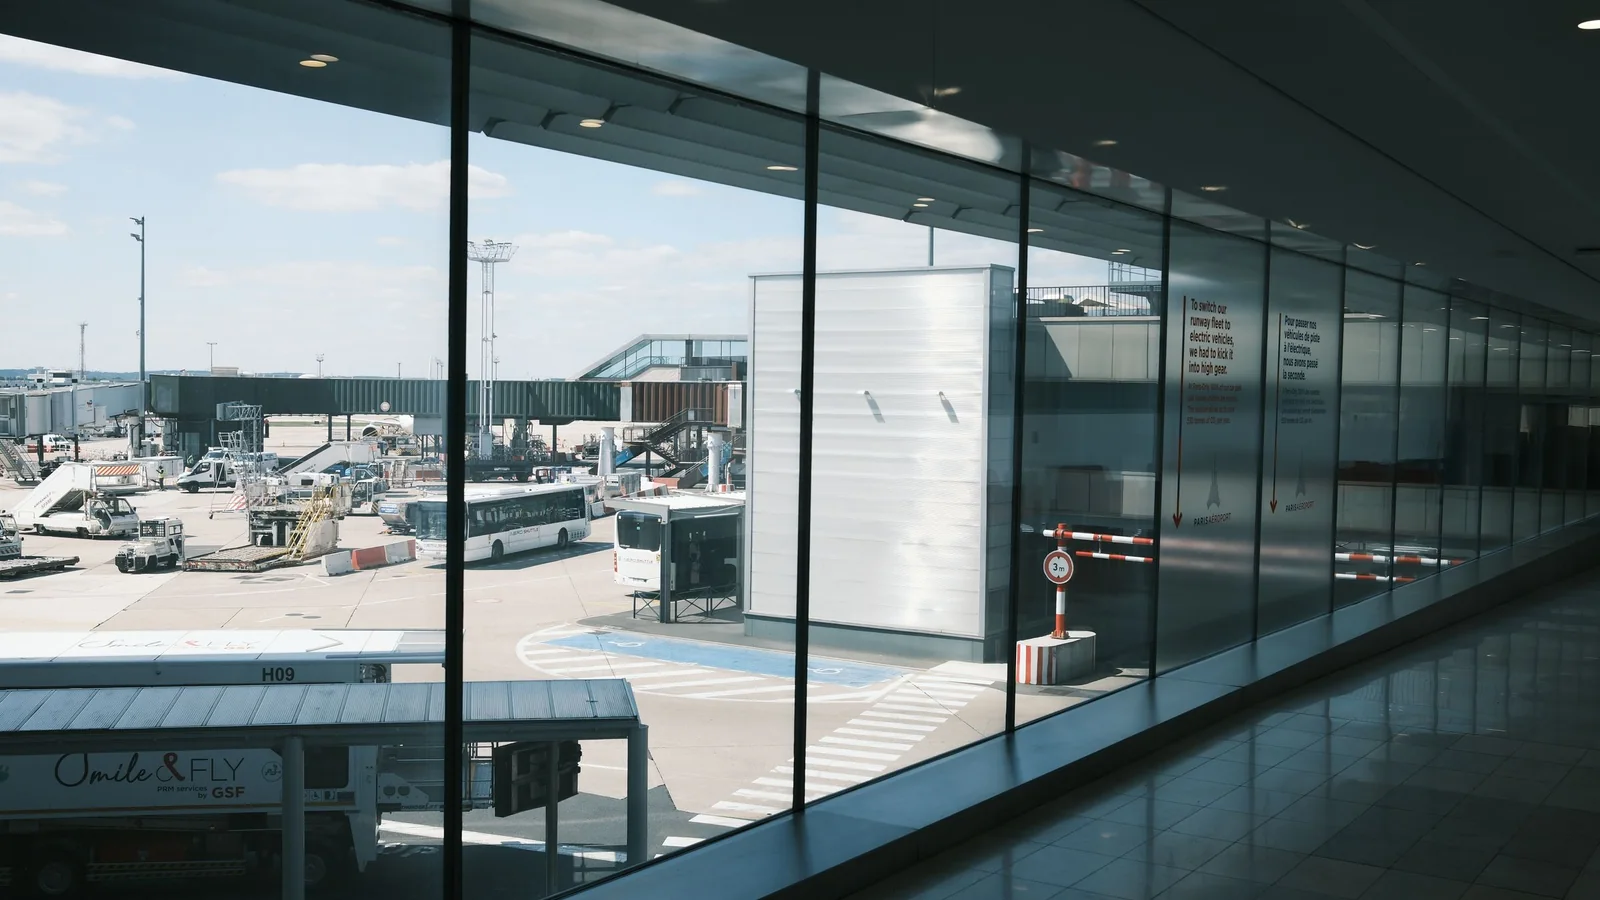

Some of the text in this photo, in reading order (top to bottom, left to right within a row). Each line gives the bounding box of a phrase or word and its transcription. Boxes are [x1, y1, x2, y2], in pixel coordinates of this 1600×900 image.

[1191, 298, 1227, 314] To switch our
[1190, 316, 1231, 330] runway fleet to
[1285, 315, 1294, 326] Pour
[1295, 319, 1309, 329] passer
[1190, 330, 1234, 347] electric vehicles,
[1284, 329, 1320, 344] véhicules de piste
[1189, 345, 1233, 360] we had to kick it
[1189, 361, 1227, 376] into high gear.
[1283, 358, 1318, 370] nous avons passé
[1283, 369, 1306, 380] la seconde.
[262, 667, 295, 682] H09
[156, 752, 185, 782] &
[190, 758, 244, 782] FLY
[212, 786, 245, 798] GSF
